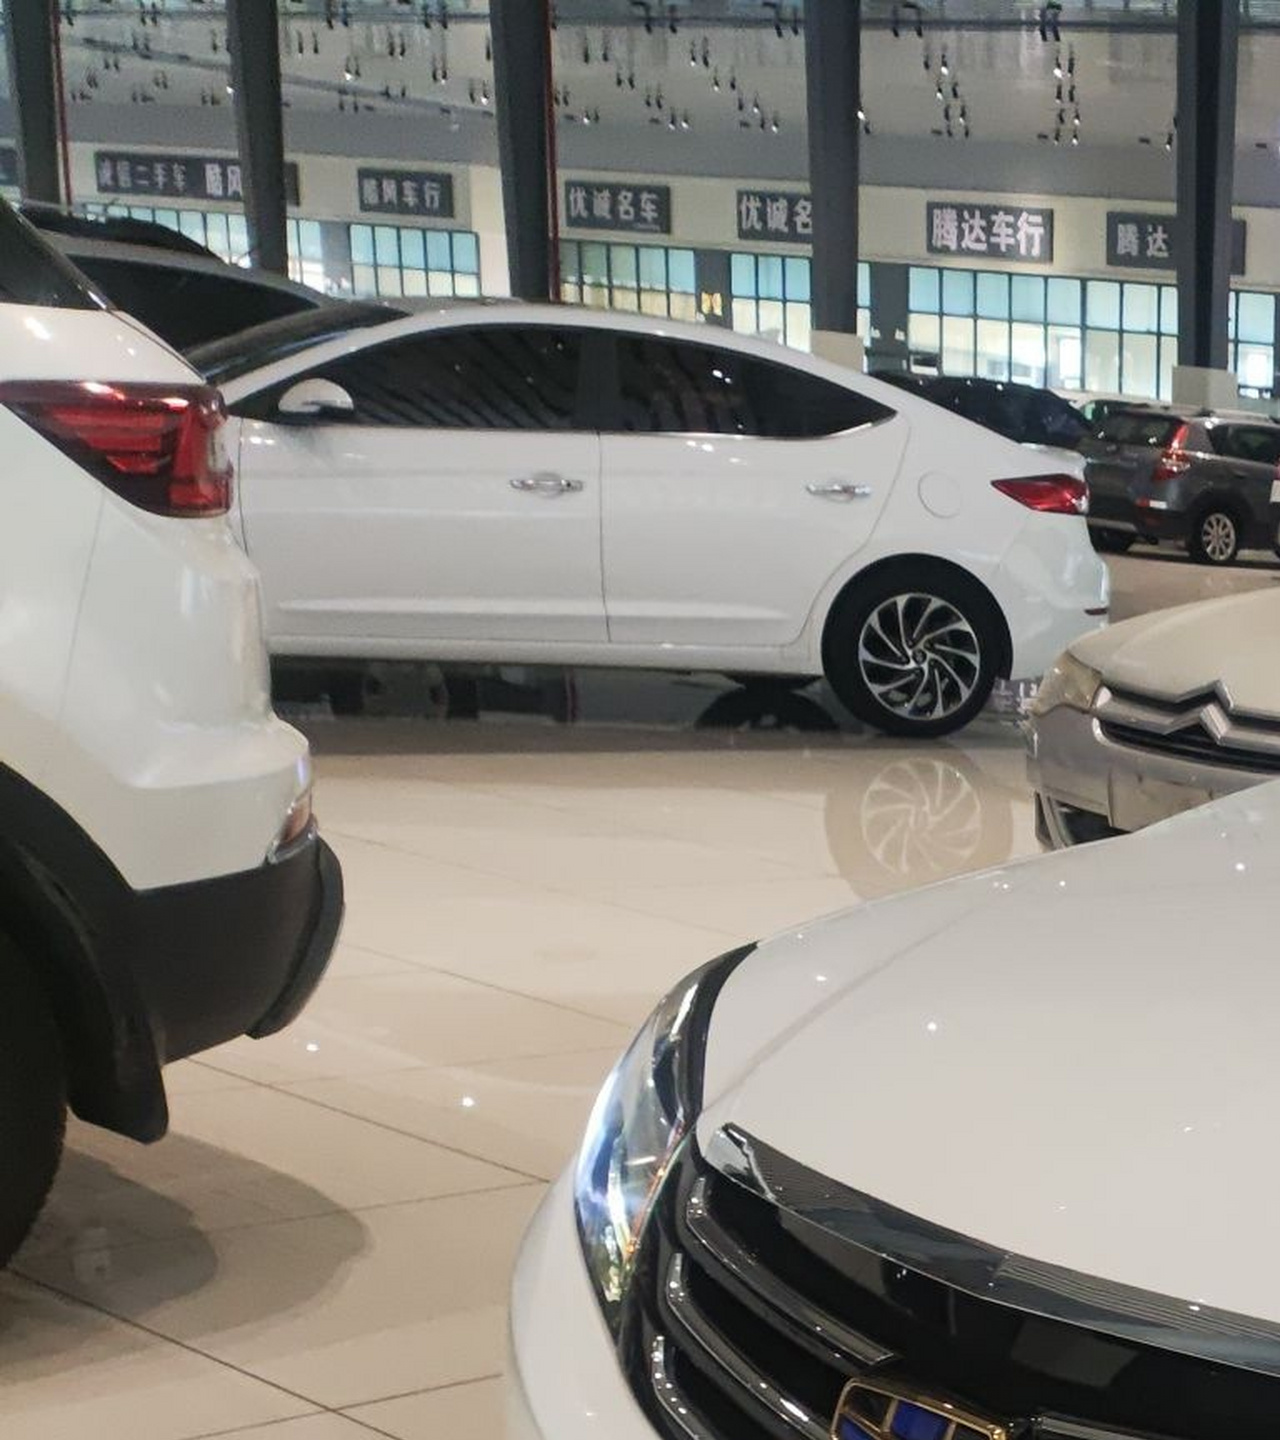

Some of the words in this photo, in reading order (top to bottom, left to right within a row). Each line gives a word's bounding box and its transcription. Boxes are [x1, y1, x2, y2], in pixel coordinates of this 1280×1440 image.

[569, 186, 658, 222] 优诚名车
[932, 207, 1044, 257] 腾达车行
[1117, 224, 1168, 257] 腾达
